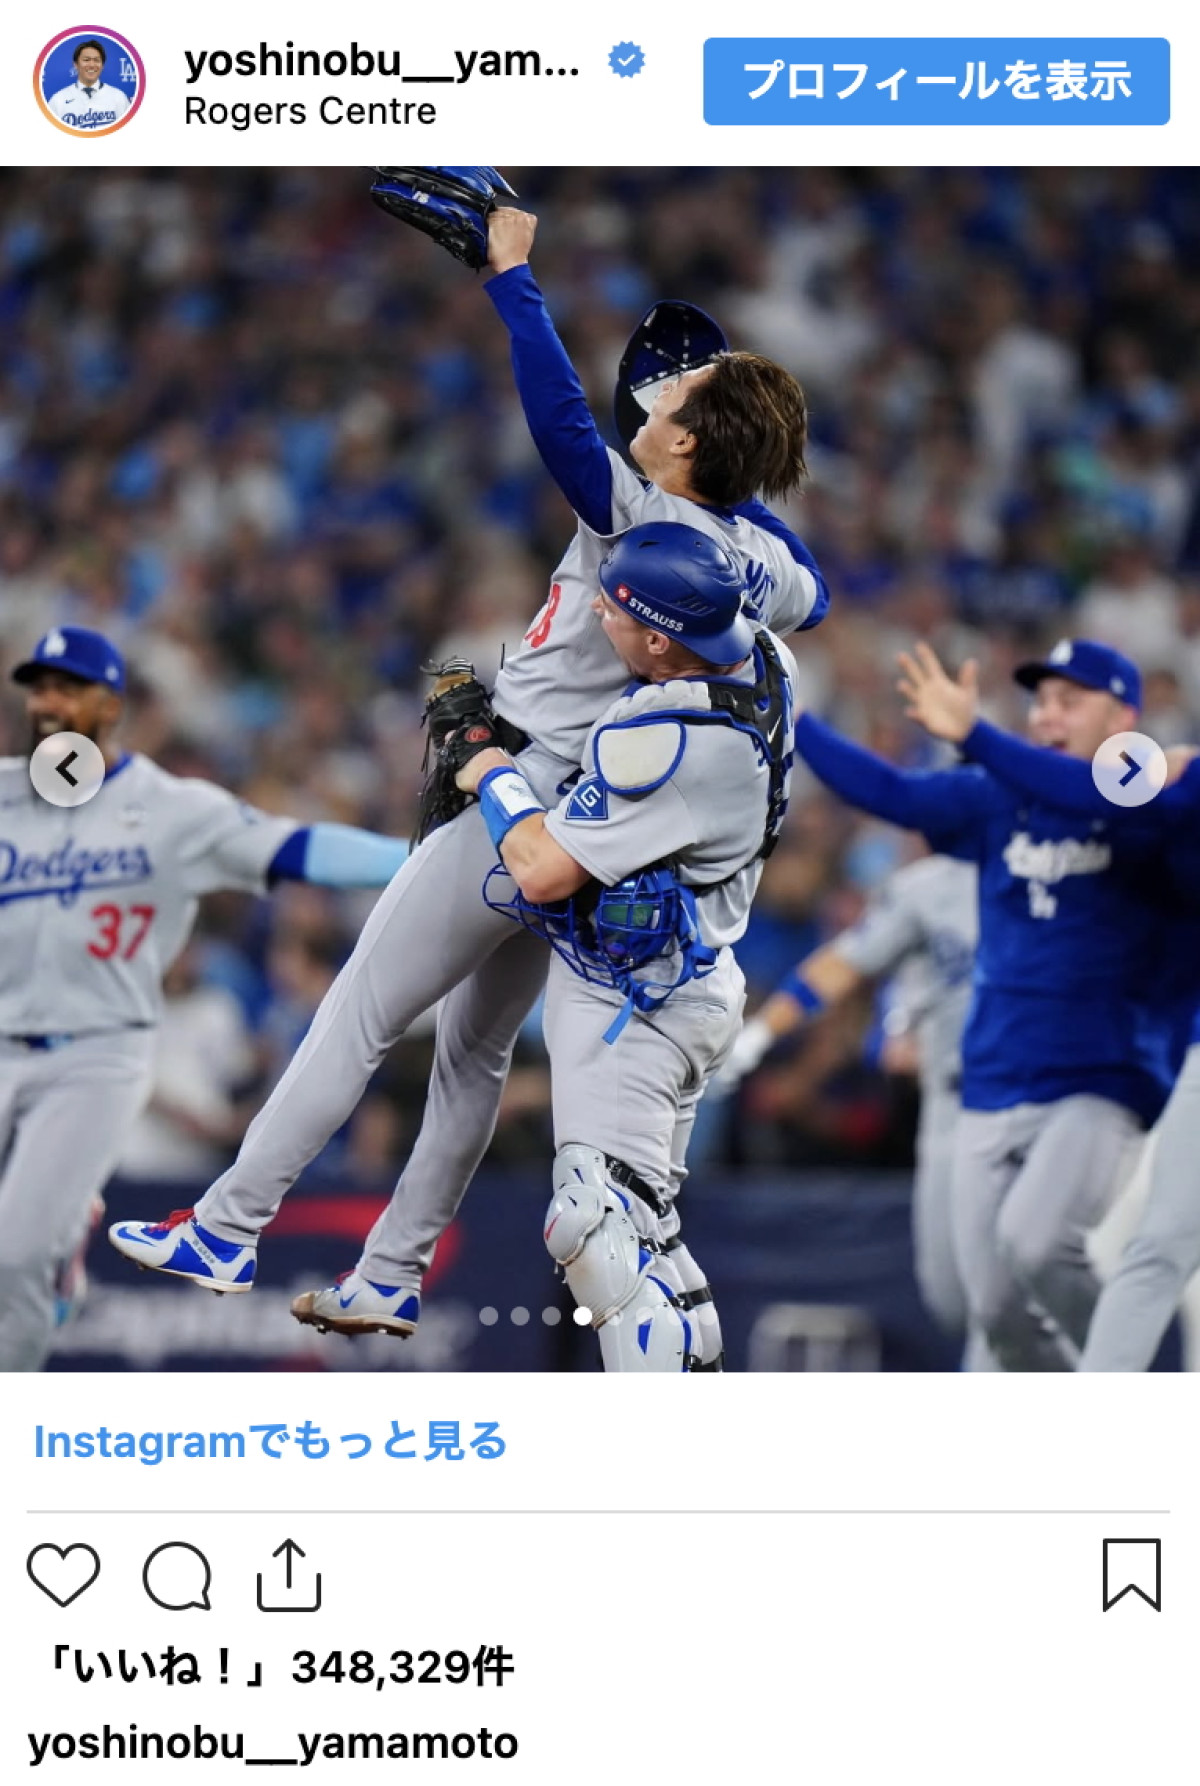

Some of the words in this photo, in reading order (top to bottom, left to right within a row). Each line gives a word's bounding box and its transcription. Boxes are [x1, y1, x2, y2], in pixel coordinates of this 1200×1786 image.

[62, 108, 117, 127] Dodgers
[628, 598, 684, 632] STRAUSS
[87, 903, 155, 961] 37
